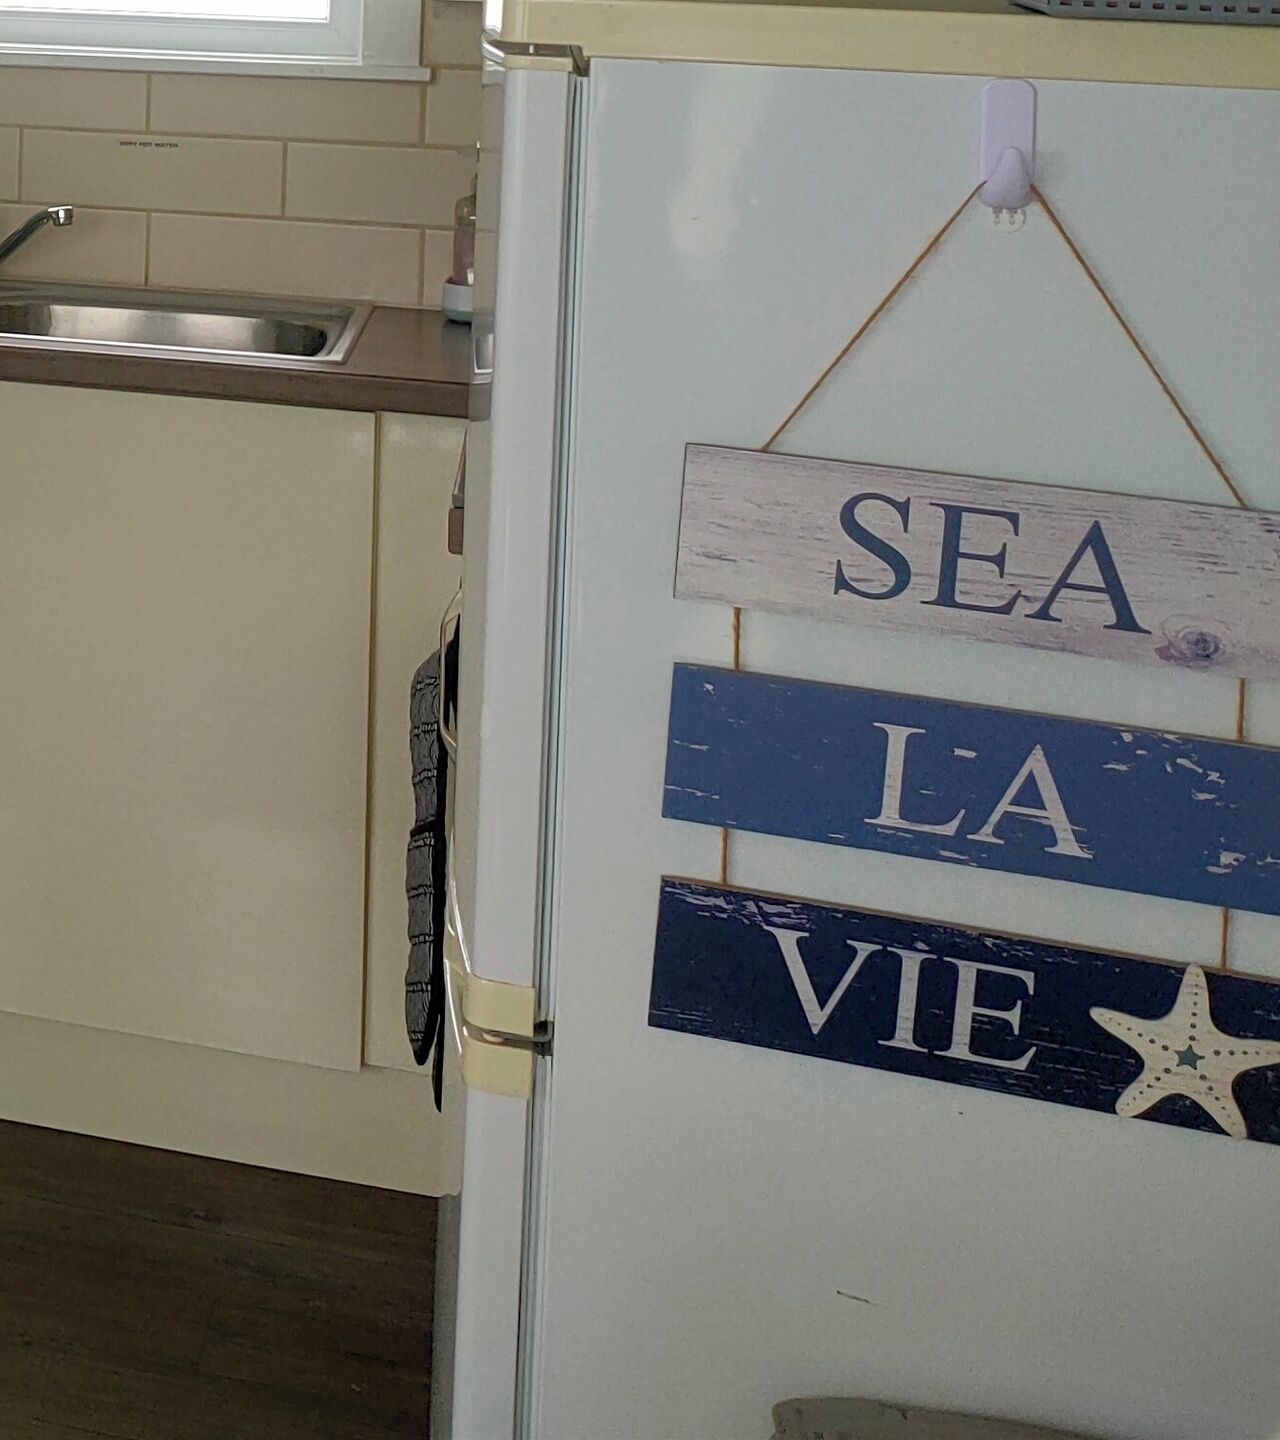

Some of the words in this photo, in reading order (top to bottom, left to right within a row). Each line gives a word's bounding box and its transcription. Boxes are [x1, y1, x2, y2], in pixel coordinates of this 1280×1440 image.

[831, 490, 1152, 635] SEA
[863, 720, 1093, 860] LA
[762, 923, 1039, 1072] VIE
